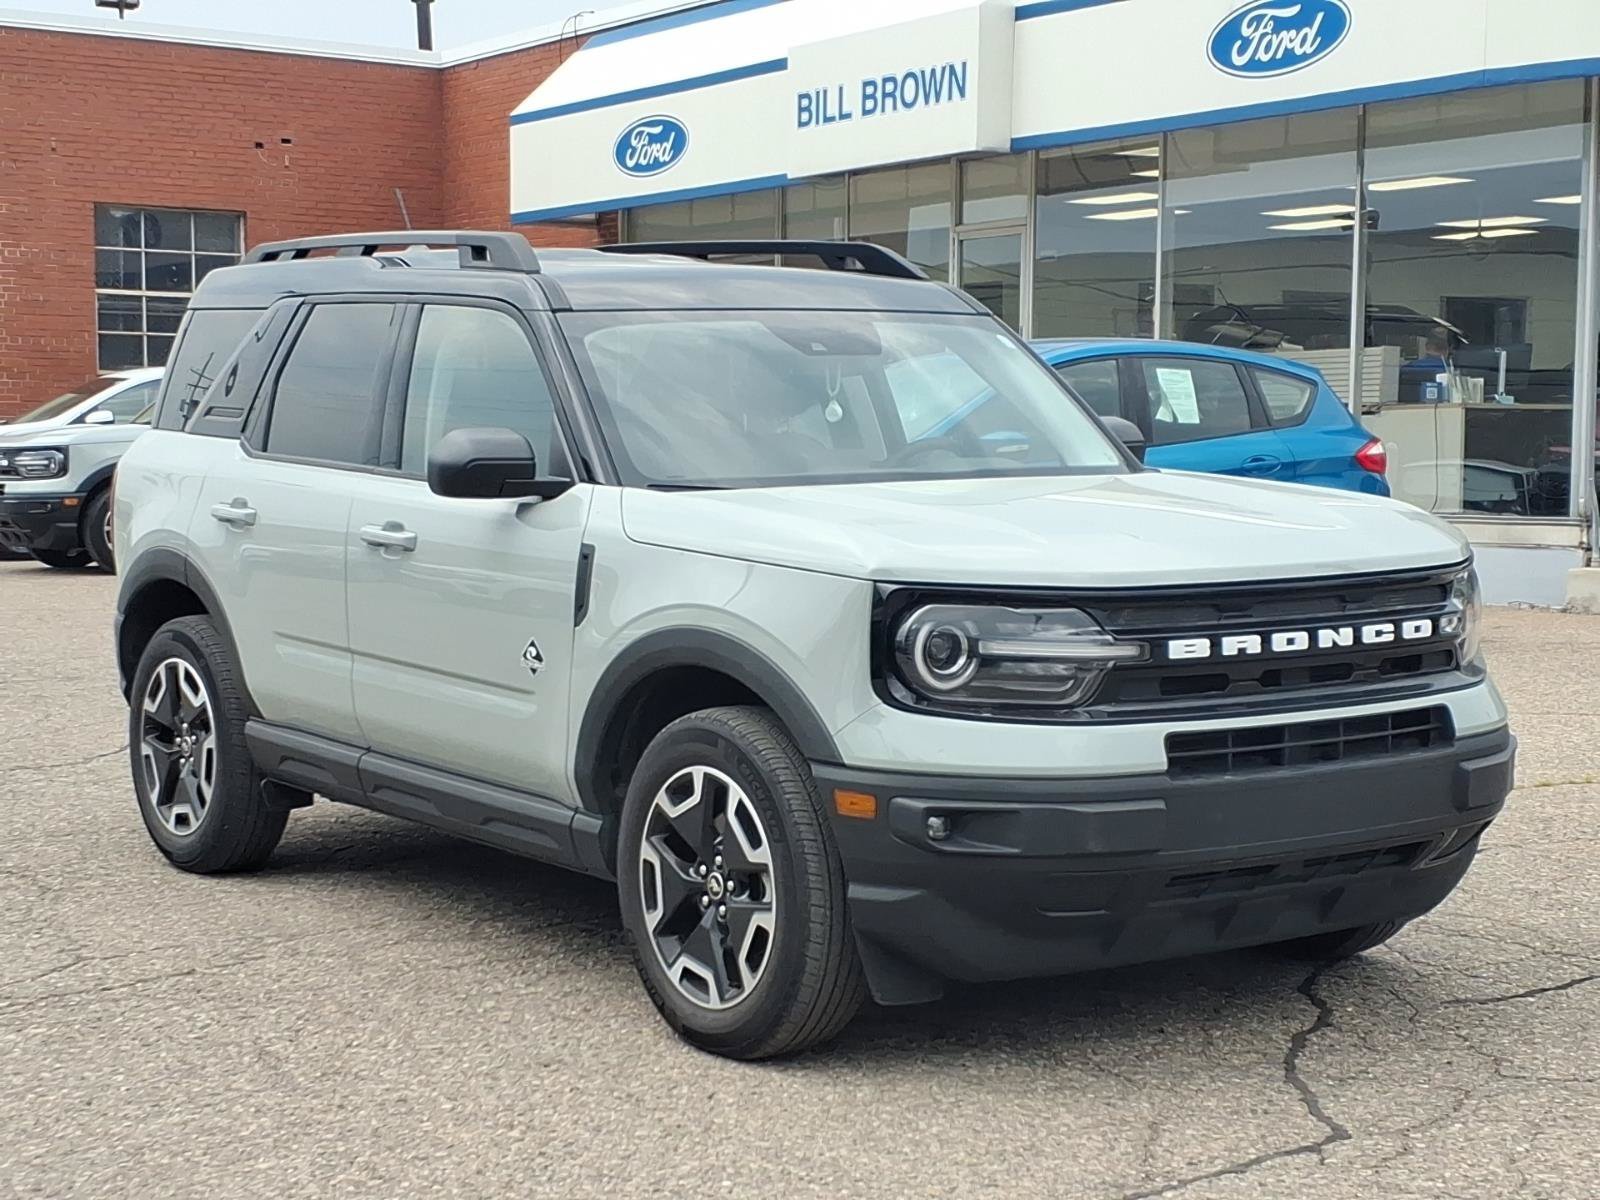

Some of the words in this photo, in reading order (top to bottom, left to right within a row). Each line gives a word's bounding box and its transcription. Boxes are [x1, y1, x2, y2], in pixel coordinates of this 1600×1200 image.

[1231, 3, 1325, 66] Ford
[797, 86, 852, 128] BILL
[861, 61, 967, 116] BROWN
[625, 124, 676, 168] Ford
[1168, 619, 1432, 659] BRONCO
